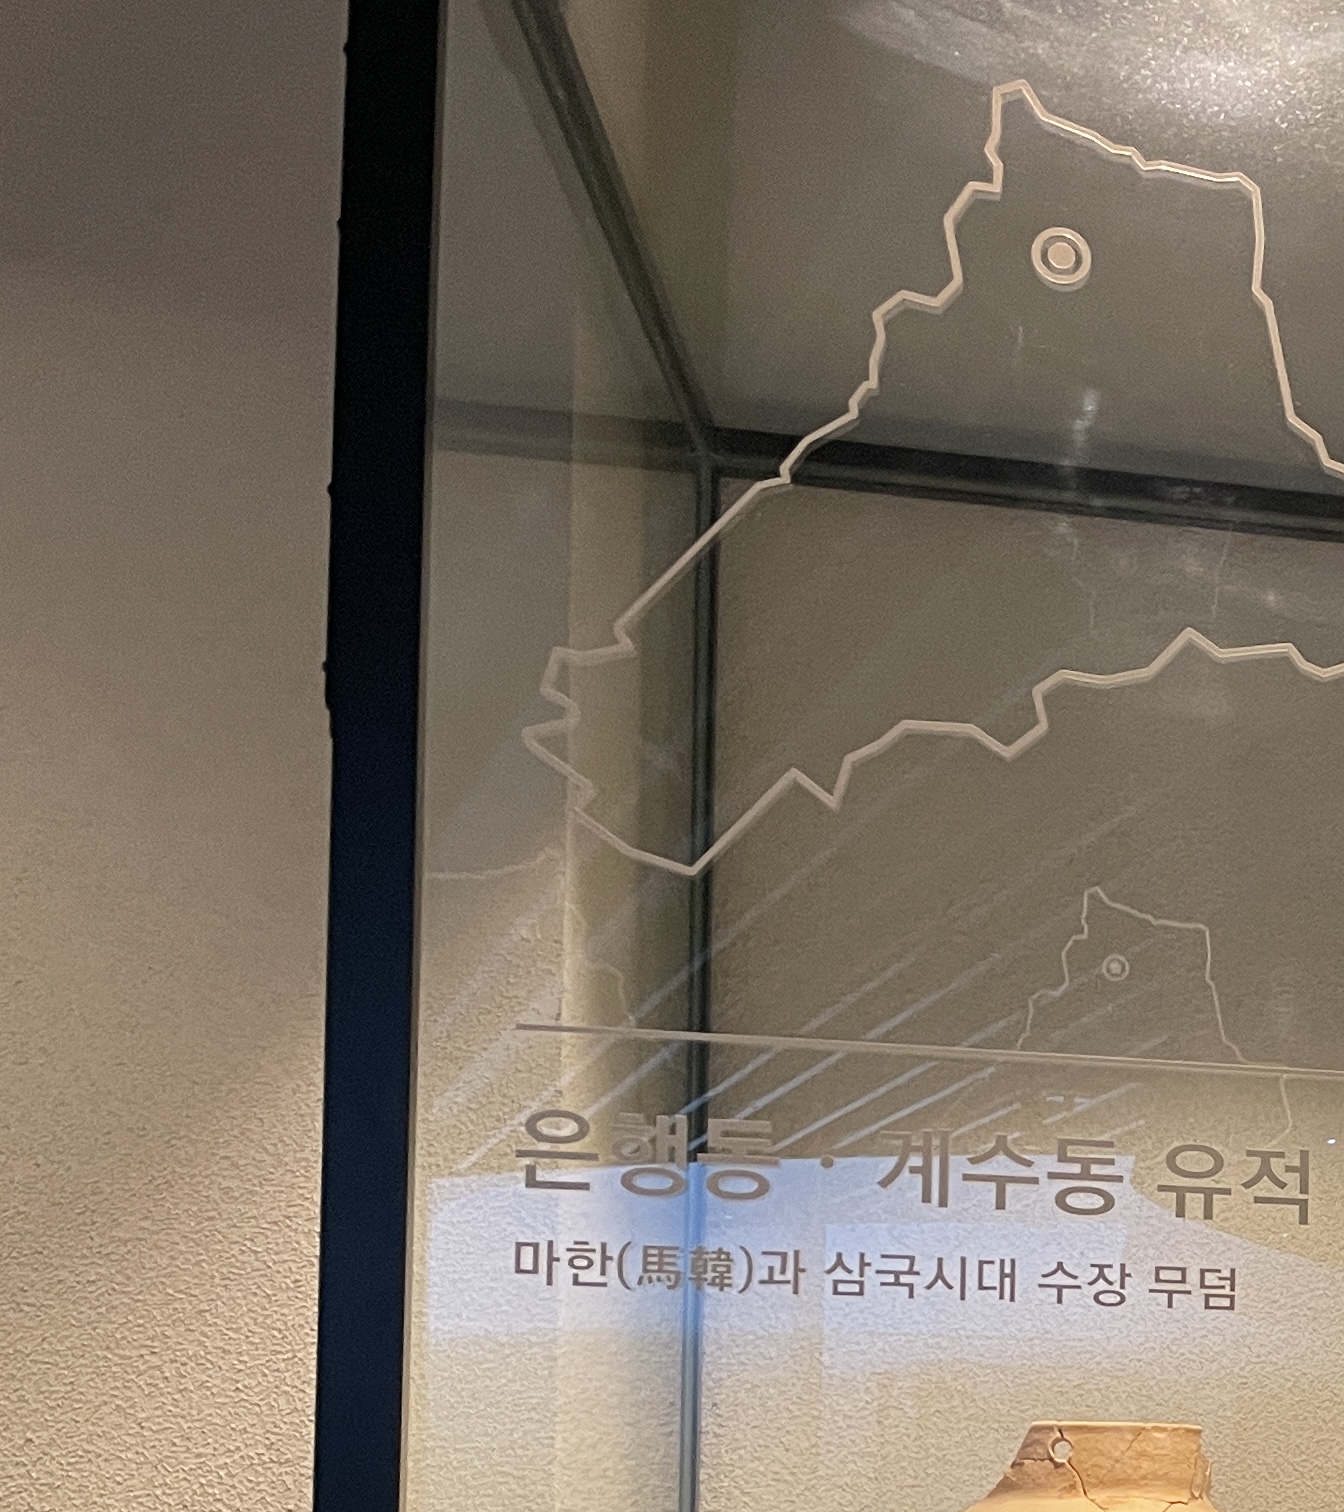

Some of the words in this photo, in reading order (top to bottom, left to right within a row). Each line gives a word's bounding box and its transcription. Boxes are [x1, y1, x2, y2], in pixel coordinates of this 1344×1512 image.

[515, 1109, 782, 1200] 은행동
[876, 1129, 1125, 1216] 계수동
[1156, 1143, 1310, 1226] 유적
[514, 1240, 807, 1295] 마한(馬韓)과
[824, 1251, 1016, 1302] 삼국시대
[1037, 1261, 1133, 1307] 수장
[1148, 1264, 1236, 1311] 무덤
